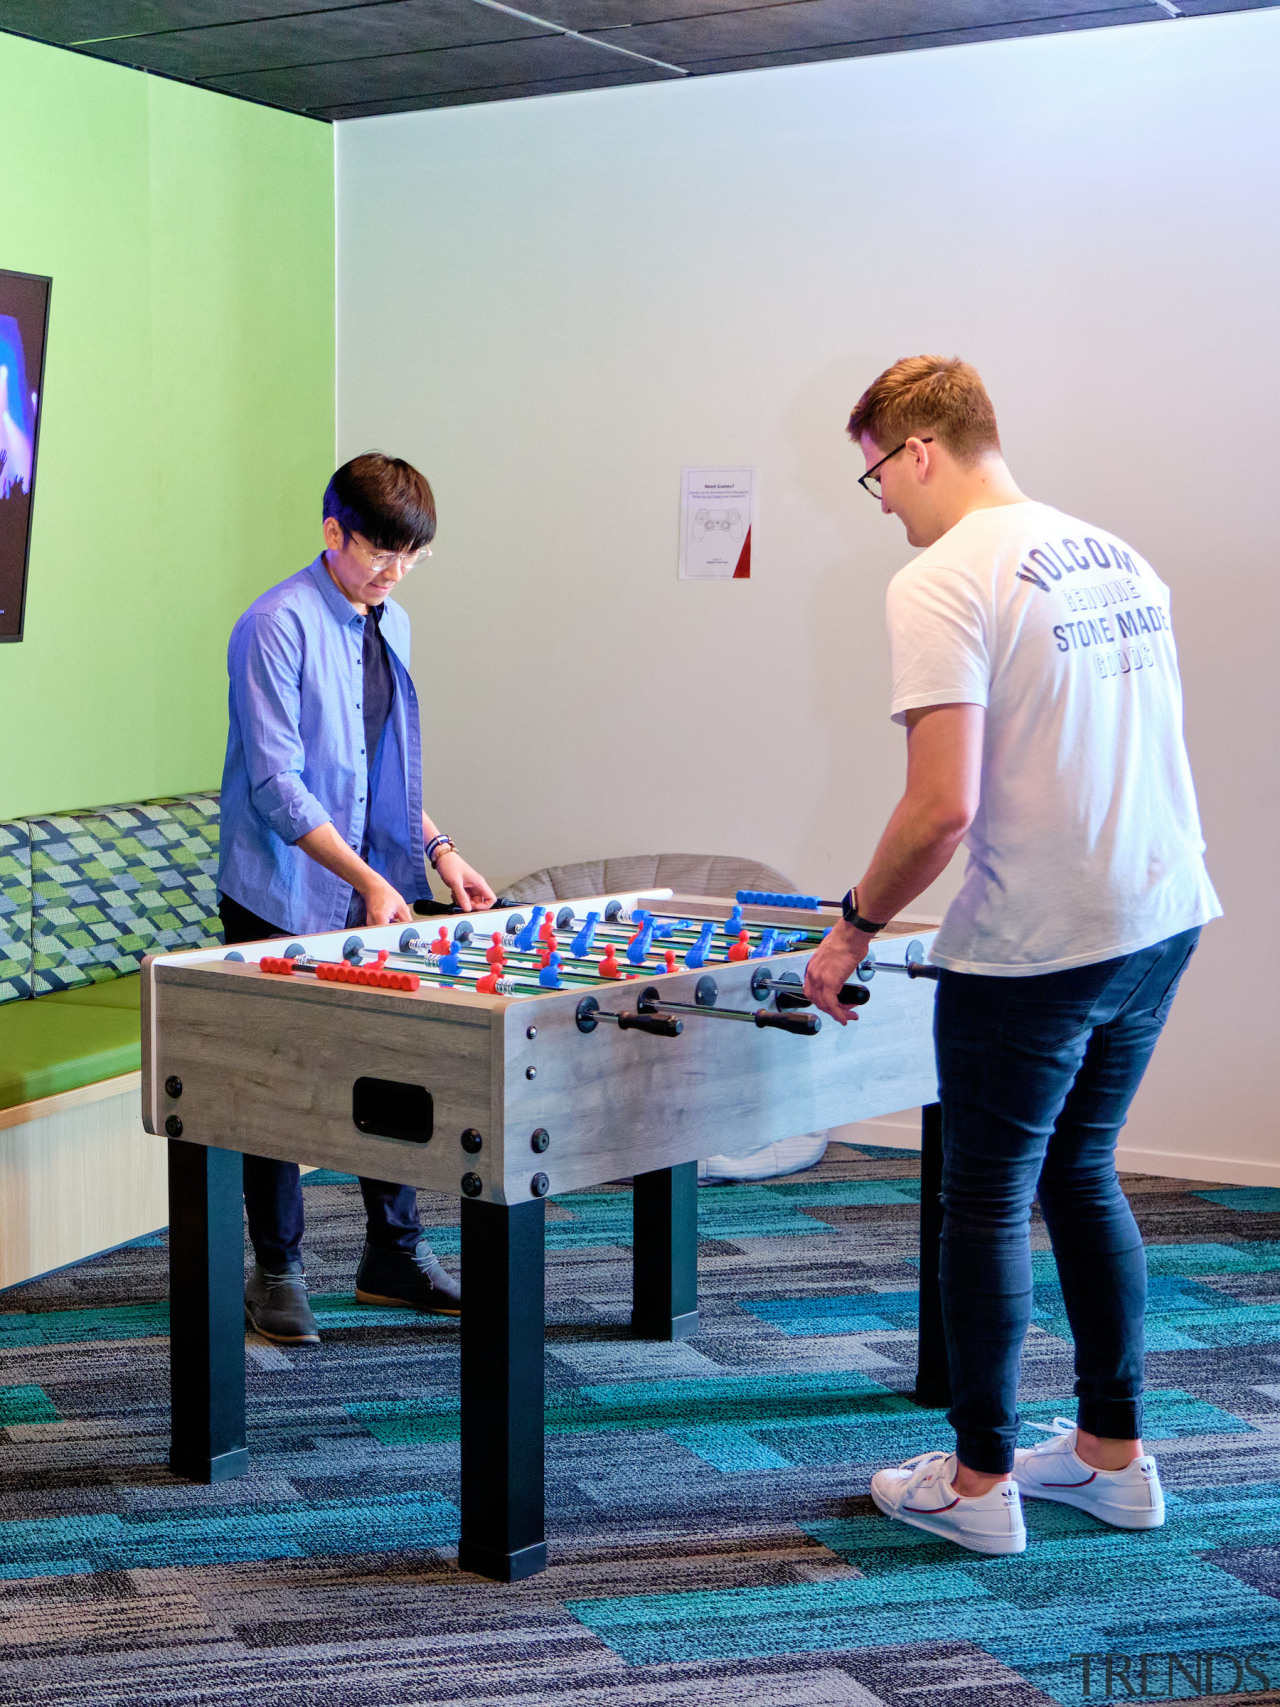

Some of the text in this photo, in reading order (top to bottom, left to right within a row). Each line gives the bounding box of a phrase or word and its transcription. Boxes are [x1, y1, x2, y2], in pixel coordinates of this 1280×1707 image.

[1015, 537, 1142, 593] VOLCOM
[1061, 578, 1141, 612] GENUINE
[1053, 605, 1170, 653] STONE MADE
[1094, 643, 1154, 680] GOODS
